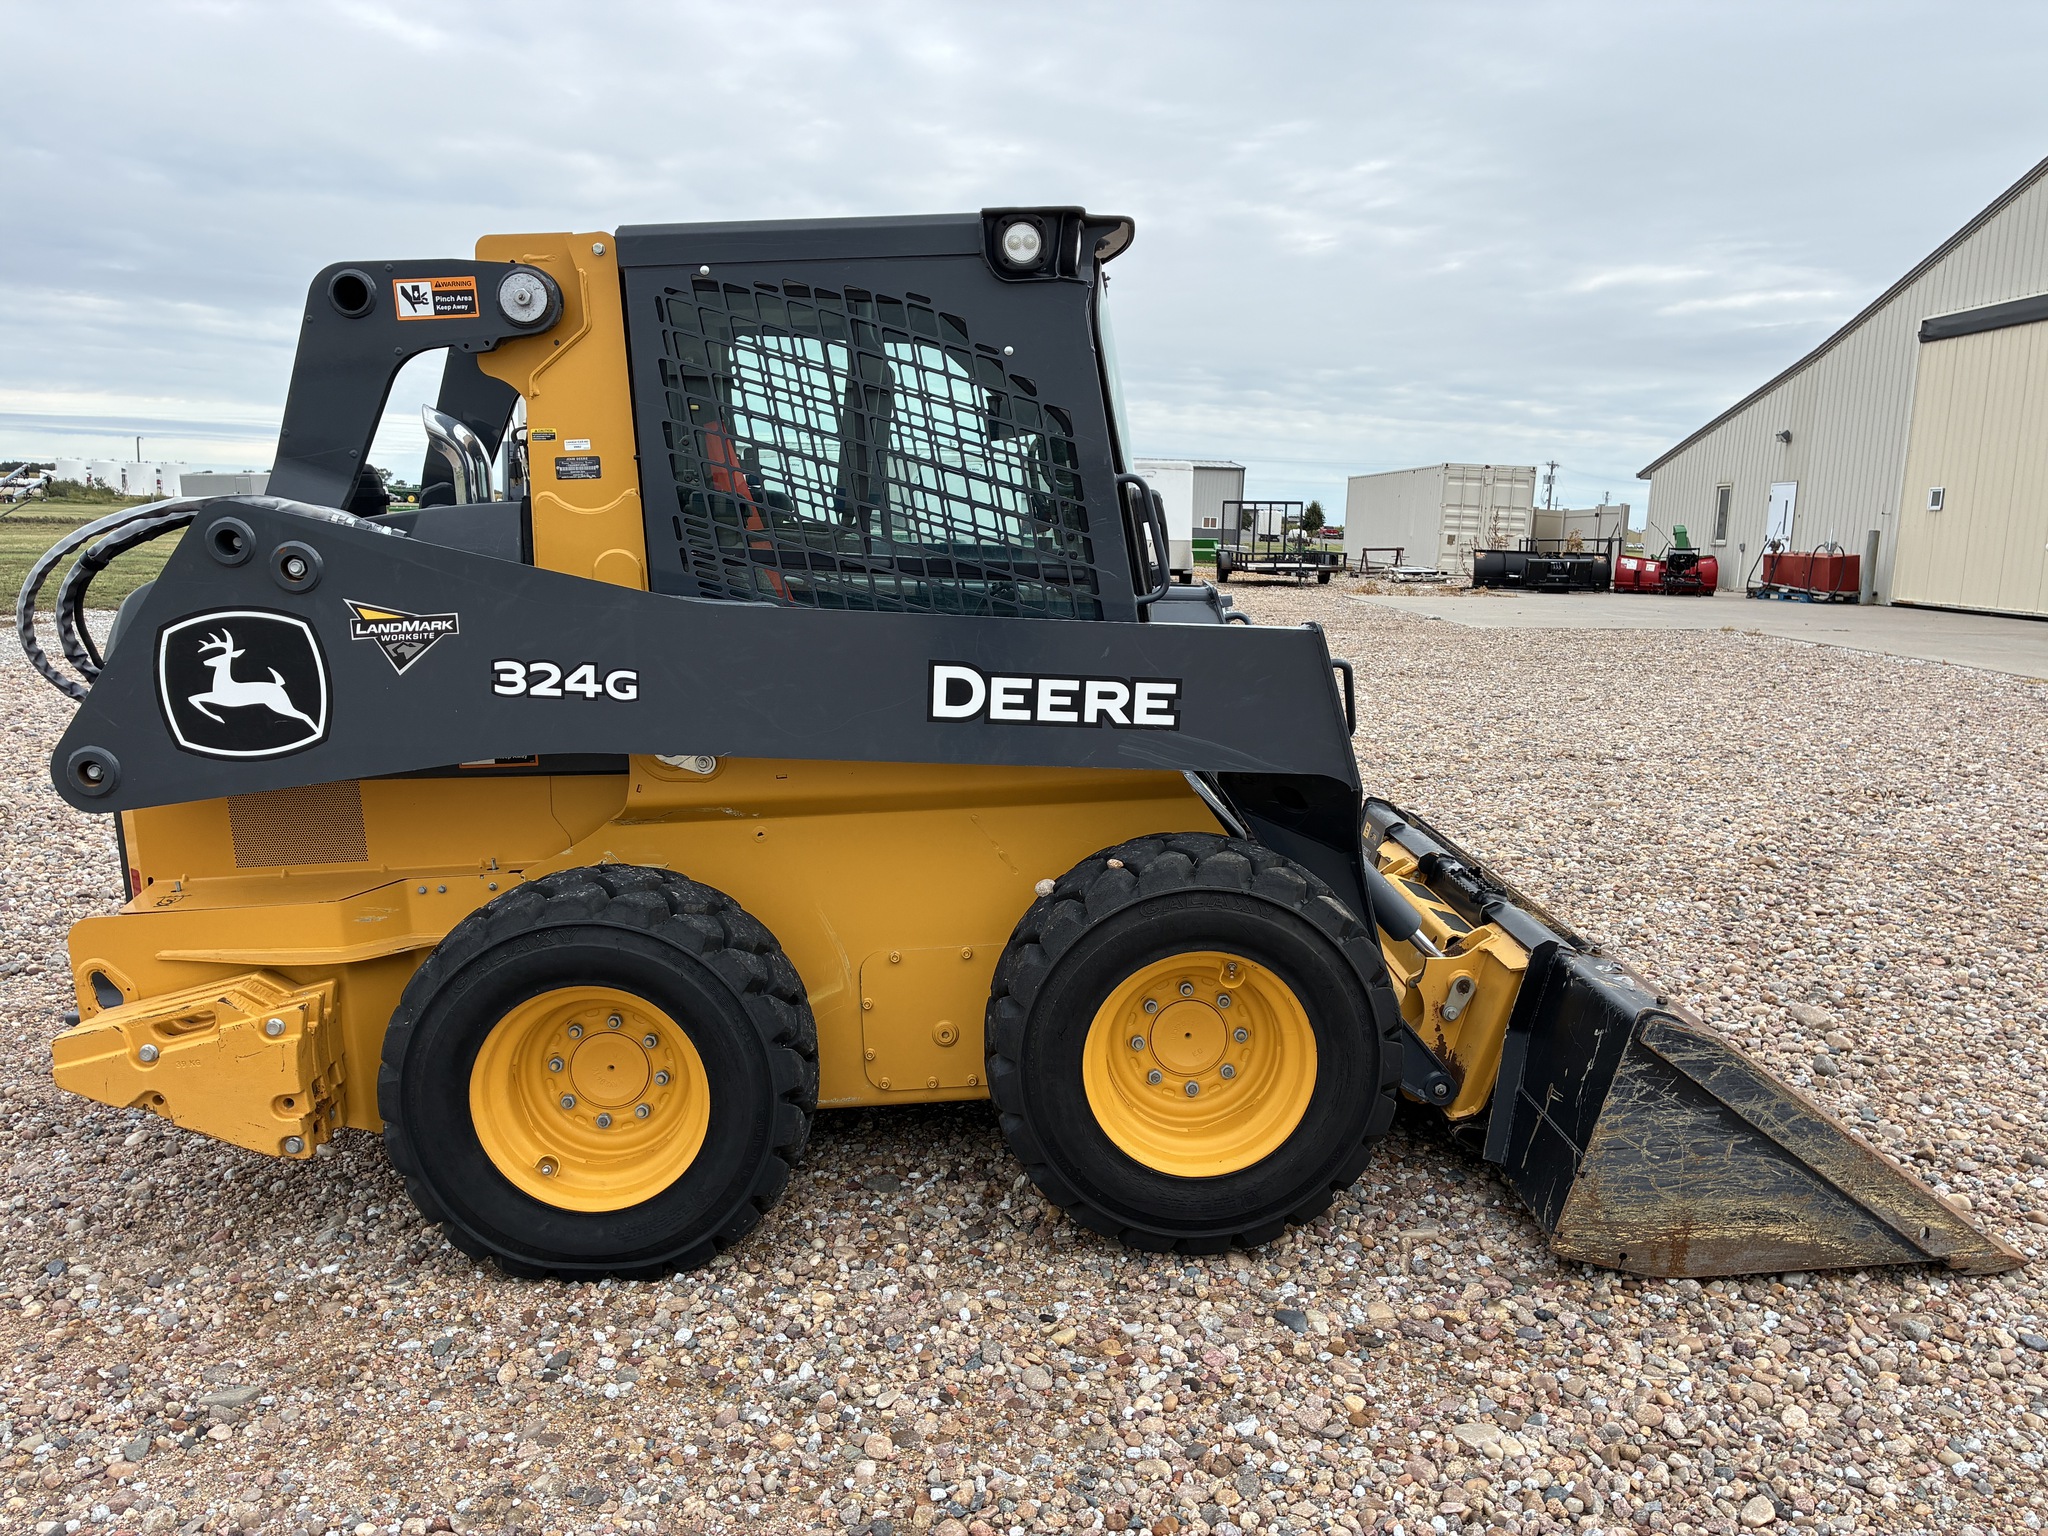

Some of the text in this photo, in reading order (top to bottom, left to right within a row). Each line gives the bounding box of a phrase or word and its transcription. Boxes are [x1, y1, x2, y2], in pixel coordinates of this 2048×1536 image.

[456, 294, 473, 302] Area
[355, 620, 454, 635] LANDMARK
[380, 632, 435, 642] WORKSITE
[493, 660, 638, 701] 324G
[932, 665, 1178, 726] DEERE
[1139, 893, 1274, 919] GALAXY
[451, 927, 579, 993] GALAXY
